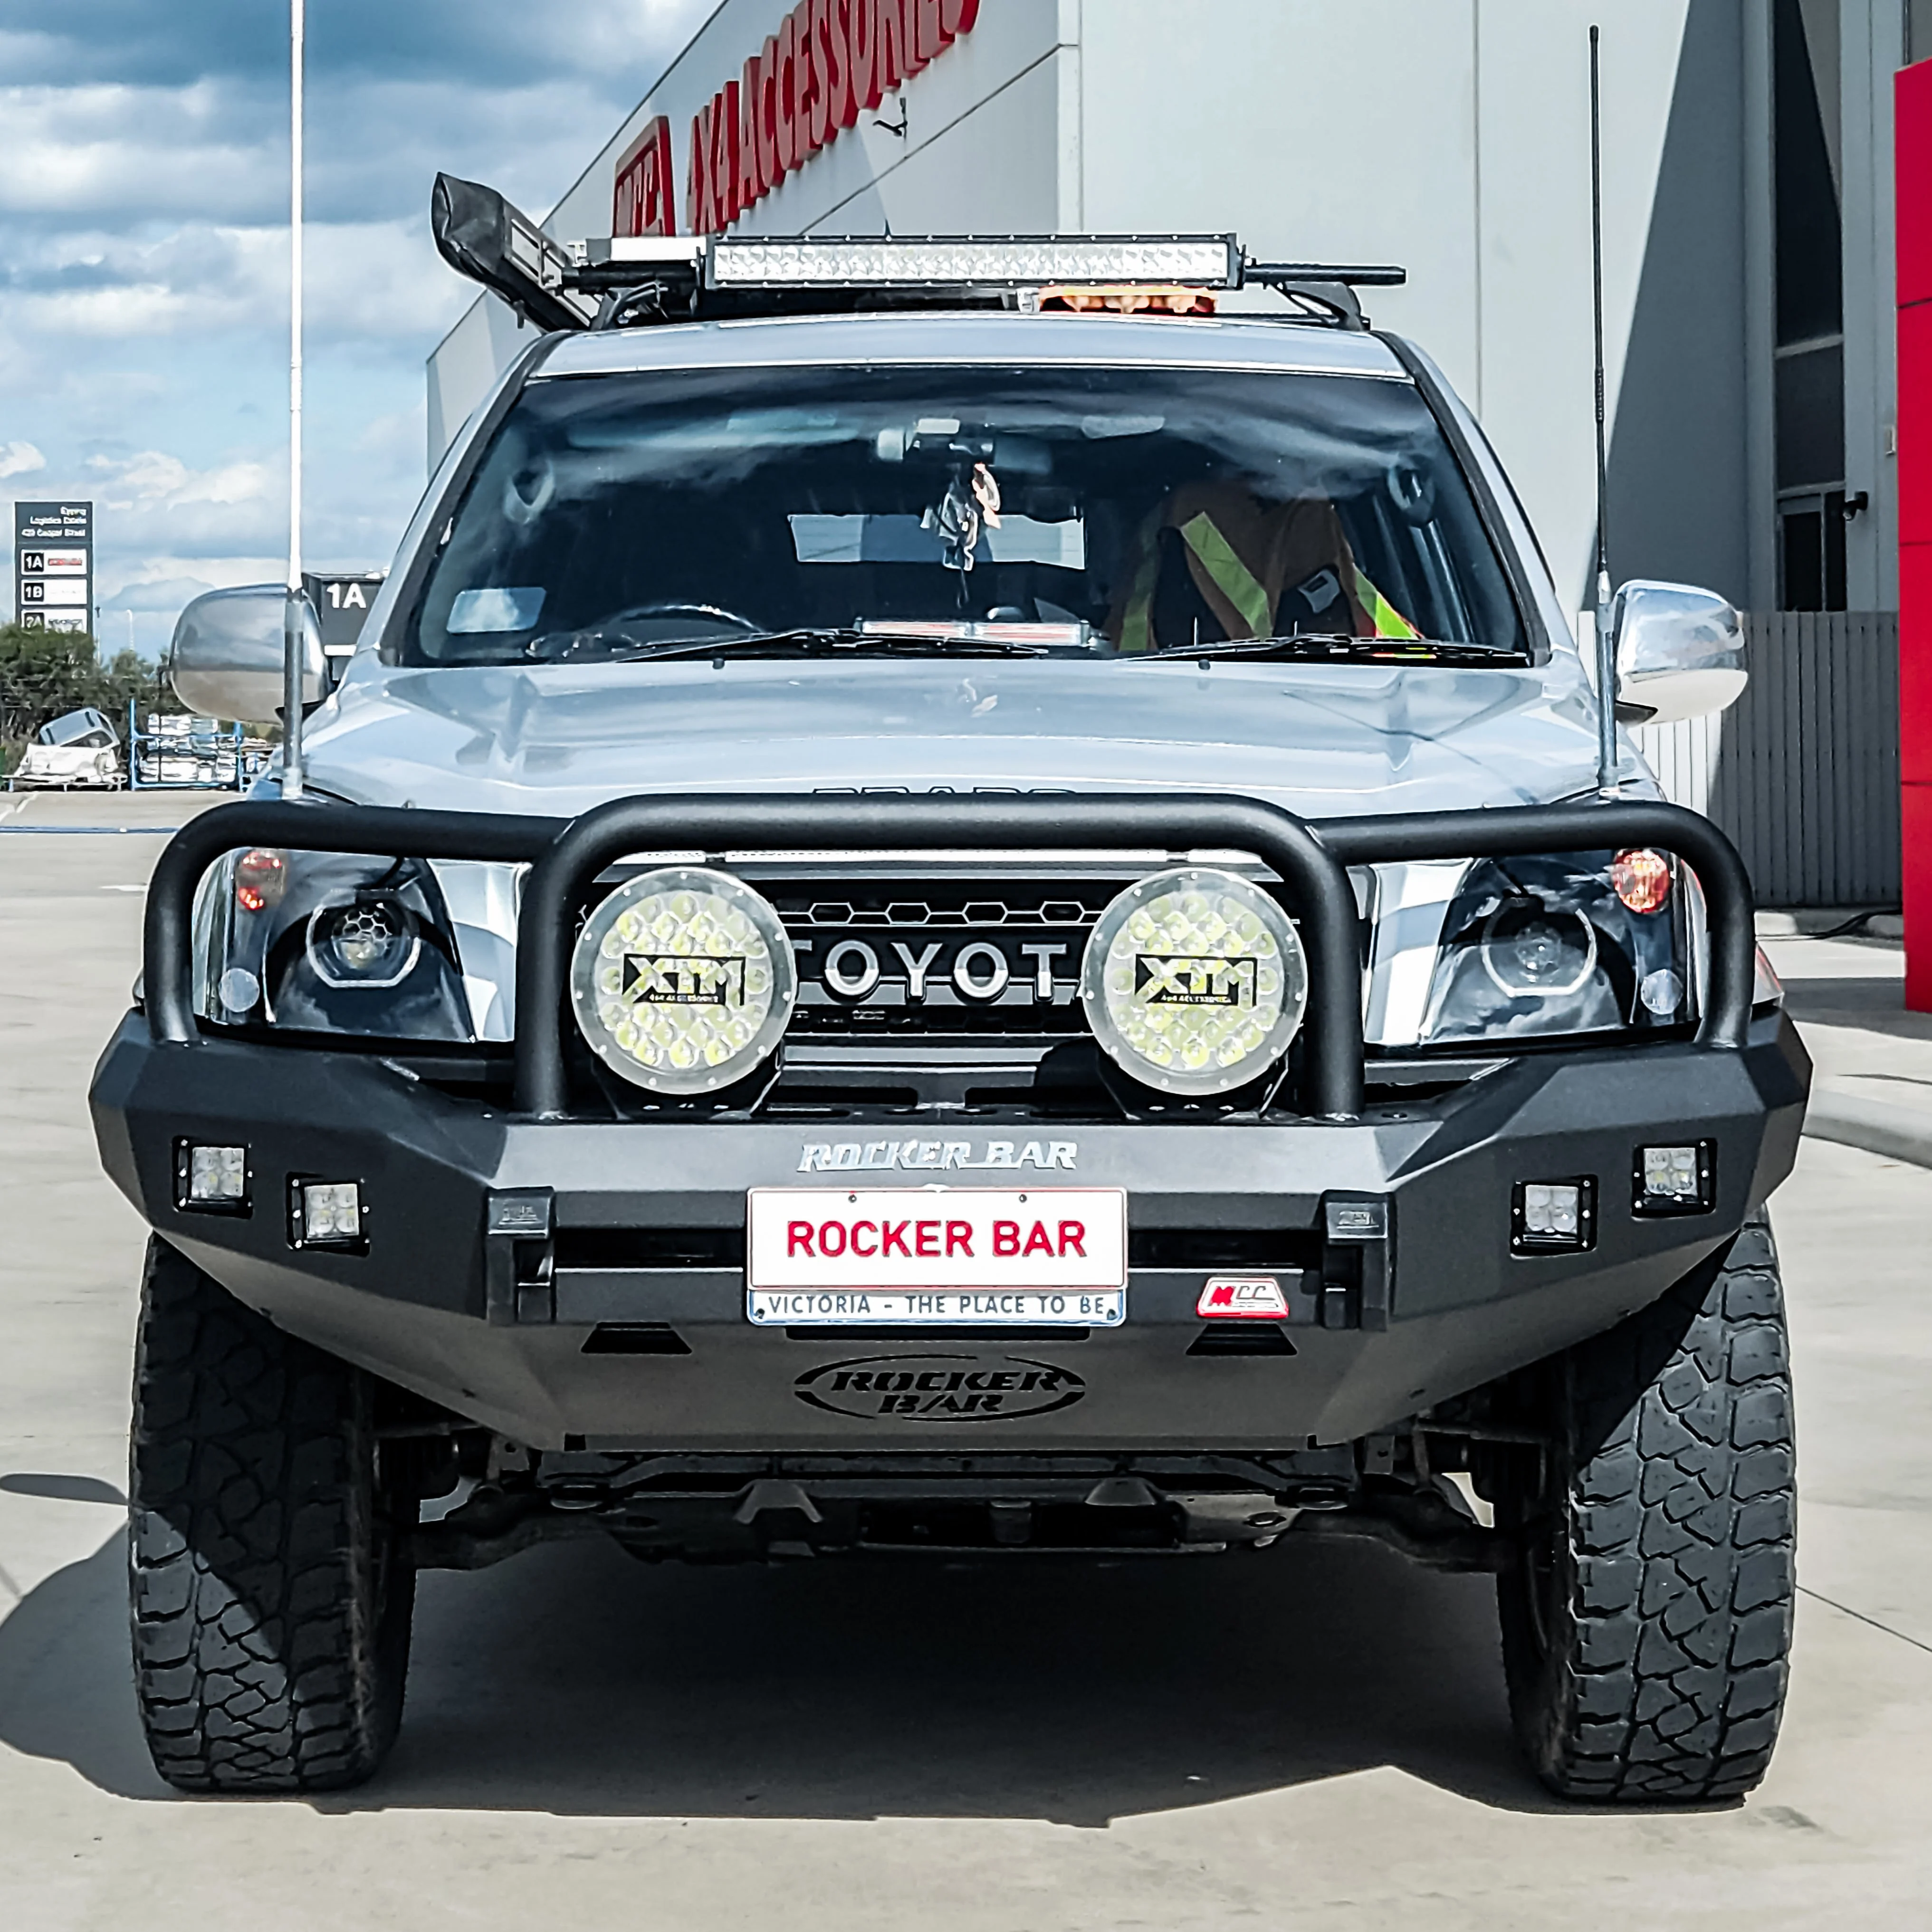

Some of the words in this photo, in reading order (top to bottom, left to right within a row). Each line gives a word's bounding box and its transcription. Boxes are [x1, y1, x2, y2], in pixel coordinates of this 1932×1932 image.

[738, 0, 980, 210] ACCESSOR
[26, 555, 43, 569] 1A
[26, 585, 43, 598] 1B
[326, 583, 366, 608] 1A
[622, 956, 742, 1009] XTM
[792, 939, 1081, 1000] OYOT
[1135, 957, 1254, 1009] XTM
[796, 1141, 971, 1172] ROCKER
[985, 1141, 1078, 1169] BAR
[787, 1220, 975, 1258] ROCKER
[992, 1220, 1087, 1258] BAR
[769, 1296, 871, 1313] VICTORIA
[908, 1296, 946, 1313] THE
[960, 1296, 1025, 1313] PLACE
[1040, 1296, 1065, 1314] TO
[1080, 1296, 1104, 1314] BE
[831, 1372, 1059, 1391] ROCKER
[878, 1394, 1003, 1413] BAR
